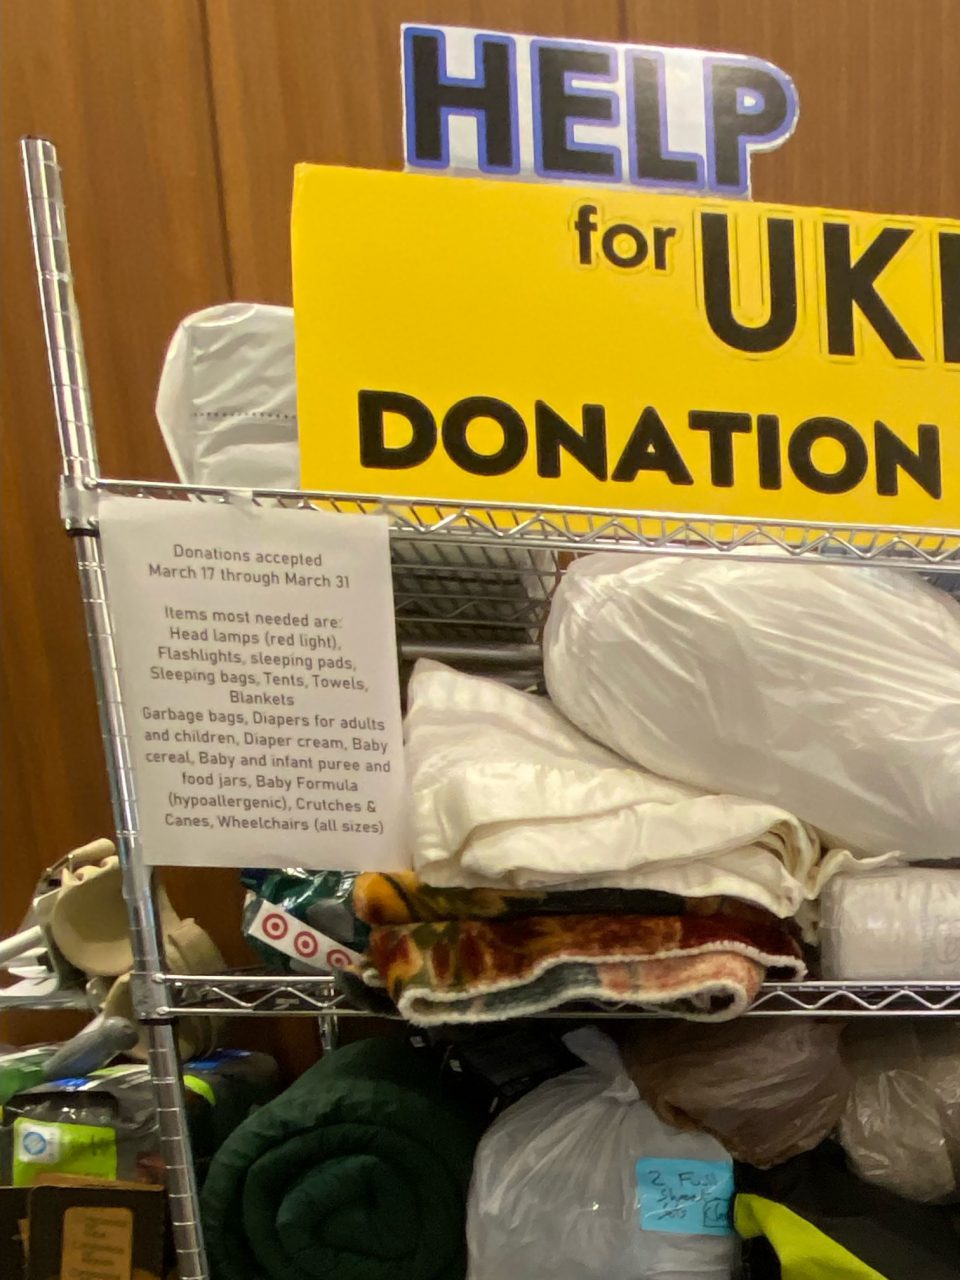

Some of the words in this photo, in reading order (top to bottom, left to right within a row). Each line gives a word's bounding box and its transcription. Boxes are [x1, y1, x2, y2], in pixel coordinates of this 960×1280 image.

[403, 27, 798, 195] HELP
[575, 204, 676, 270] for
[358, 390, 941, 500] DONATION
[173, 543, 251, 563] Donations
[255, 552, 323, 569] accepted
[148, 562, 197, 579] March
[200, 565, 215, 581] 17
[220, 567, 280, 588] through
[284, 571, 332, 588] March
[335, 574, 350, 589] 31
[164, 605, 208, 622] Items
[212, 610, 251, 624] most
[254, 612, 310, 628] needed
[169, 626, 209, 642] Head
[212, 628, 260, 647] lamps
[263, 630, 295, 648] (red
[157, 645, 247, 666] Flashlights,
[250, 651, 314, 671] sleeping
[317, 655, 357, 673] pads,
[149, 665, 216, 686] Sleeping
[219, 669, 261, 688] bags,
[262, 671, 309, 689] Tents,
[311, 673, 369, 693] Towels,
[229, 689, 295, 707] Blankets
[142, 705, 204, 725] Garbage
[207, 708, 249, 727] bags,
[252, 710, 310, 729] Diapers
[314, 714, 336, 728] for
[340, 716, 386, 732] adults
[144, 728, 170, 742] and
[173, 729, 240, 747] children,
[243, 731, 293, 750] Diaper
[296, 737, 348, 752] cream,
[351, 736, 389, 756] Baby
[198, 750, 236, 769] Baby
[240, 753, 268, 767] and
[270, 754, 314, 769] infant
[317, 759, 361, 773] puree
[365, 759, 391, 773] and
[181, 771, 215, 786] food
[218, 772, 252, 790] jars,
[255, 774, 292, 792] Baby
[296, 775, 359, 792] Formula
[168, 791, 292, 812] (hypoallergenic),
[295, 796, 362, 813] Crutches
[366, 799, 377, 814] &
[164, 812, 215, 830] Canes,
[216, 815, 310, 832] Wheelchairs
[314, 817, 339, 833] (all
[341, 820, 384, 836] sizes)
